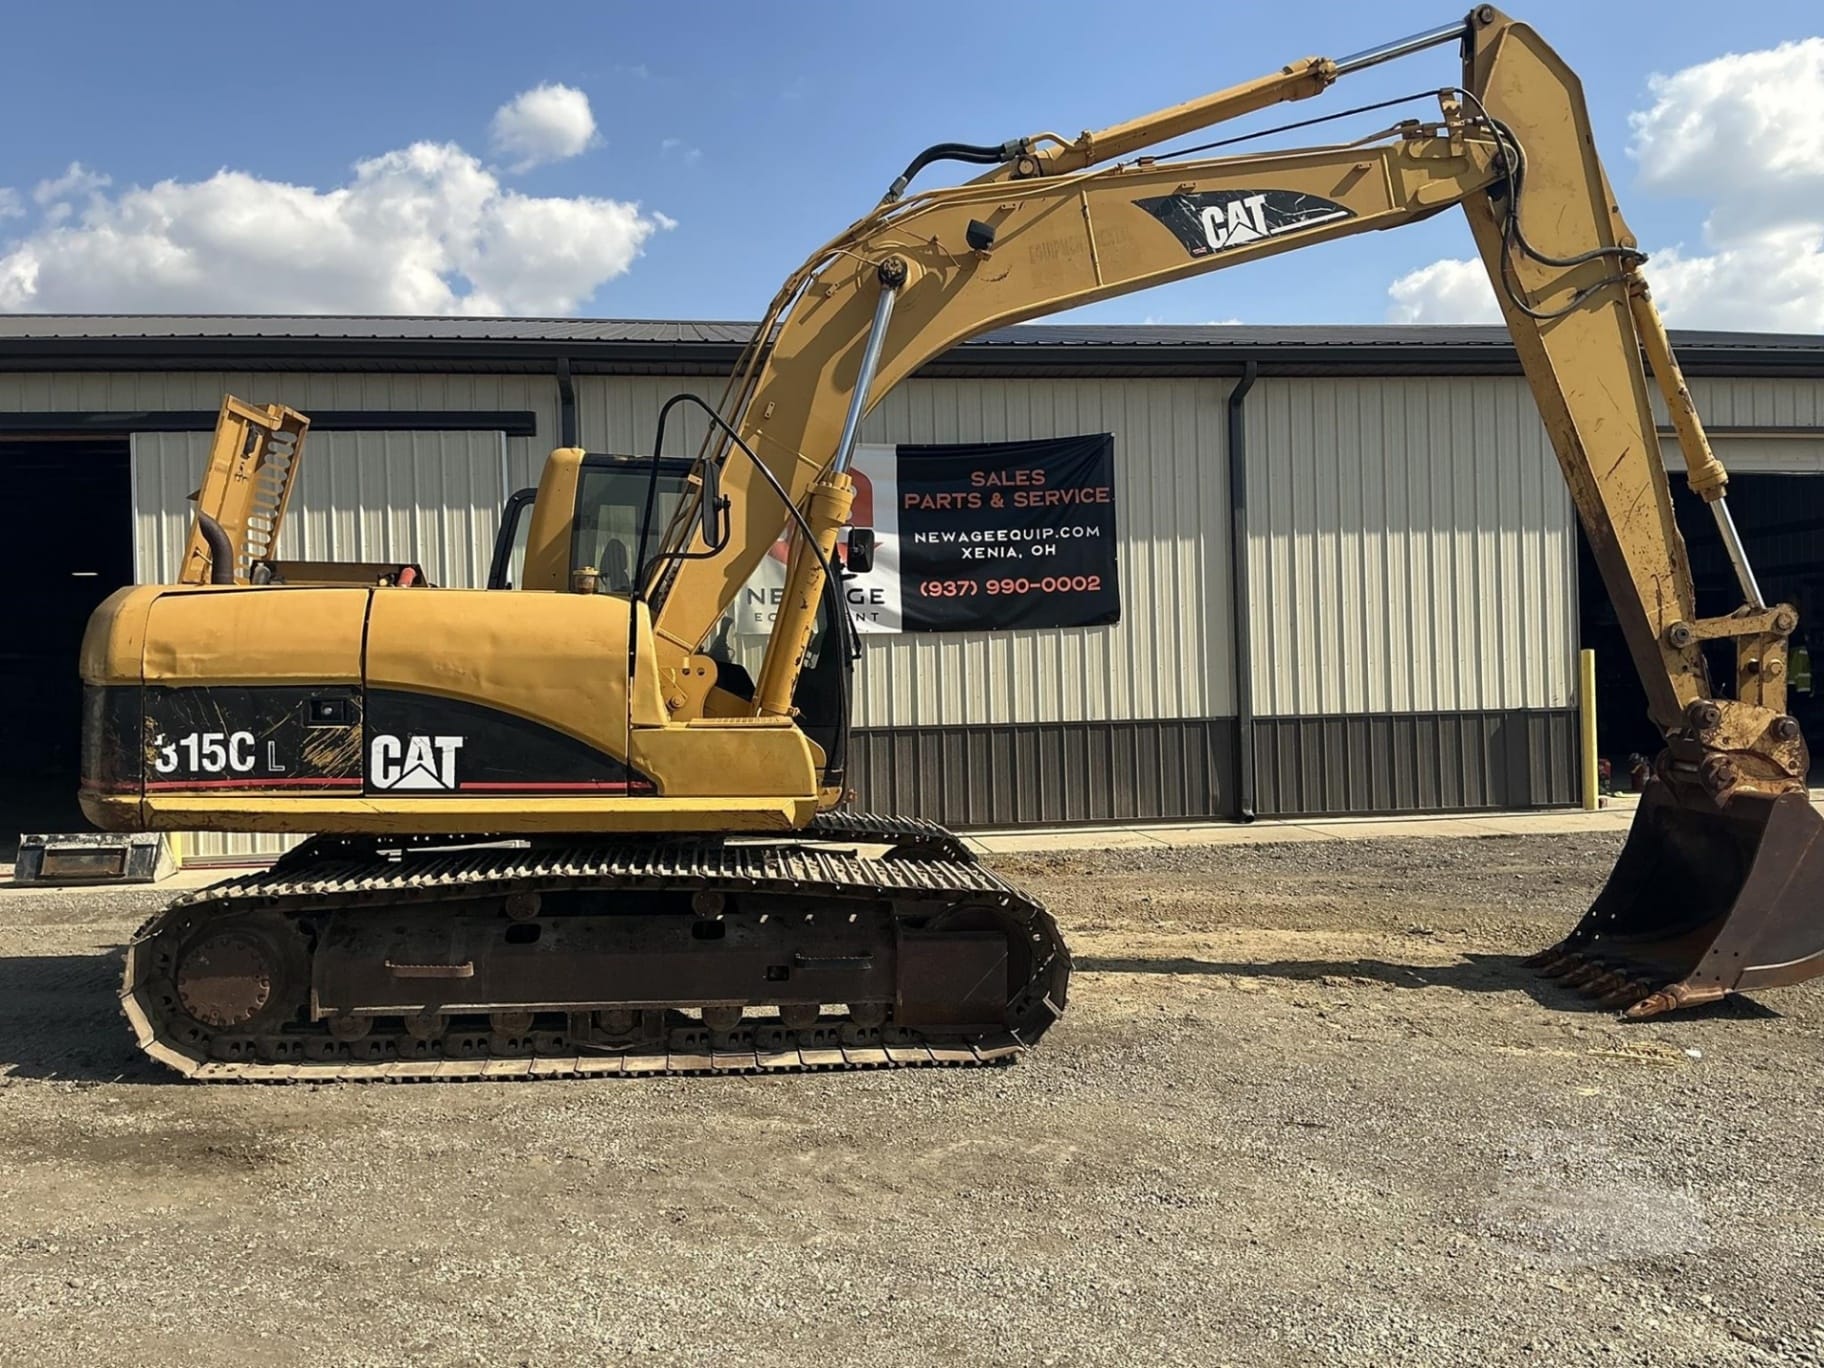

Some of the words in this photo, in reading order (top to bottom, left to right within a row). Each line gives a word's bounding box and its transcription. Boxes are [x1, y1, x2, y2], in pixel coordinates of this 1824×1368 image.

[1201, 193, 1269, 249] CAT
[970, 469, 1046, 487] SALES
[904, 492, 982, 509] PARTS
[989, 491, 1005, 508] &
[1013, 487, 1111, 508] SERVICE
[914, 526, 1101, 544] NEWAGEEQUIP.COM
[961, 546, 1023, 560] XENIA,
[1031, 543, 1057, 556] OH
[919, 580, 978, 597] (937)
[985, 575, 1101, 595] 990-0002
[154, 731, 256, 773] 315C
[267, 740, 286, 772] L
[370, 735, 464, 790] CAT
